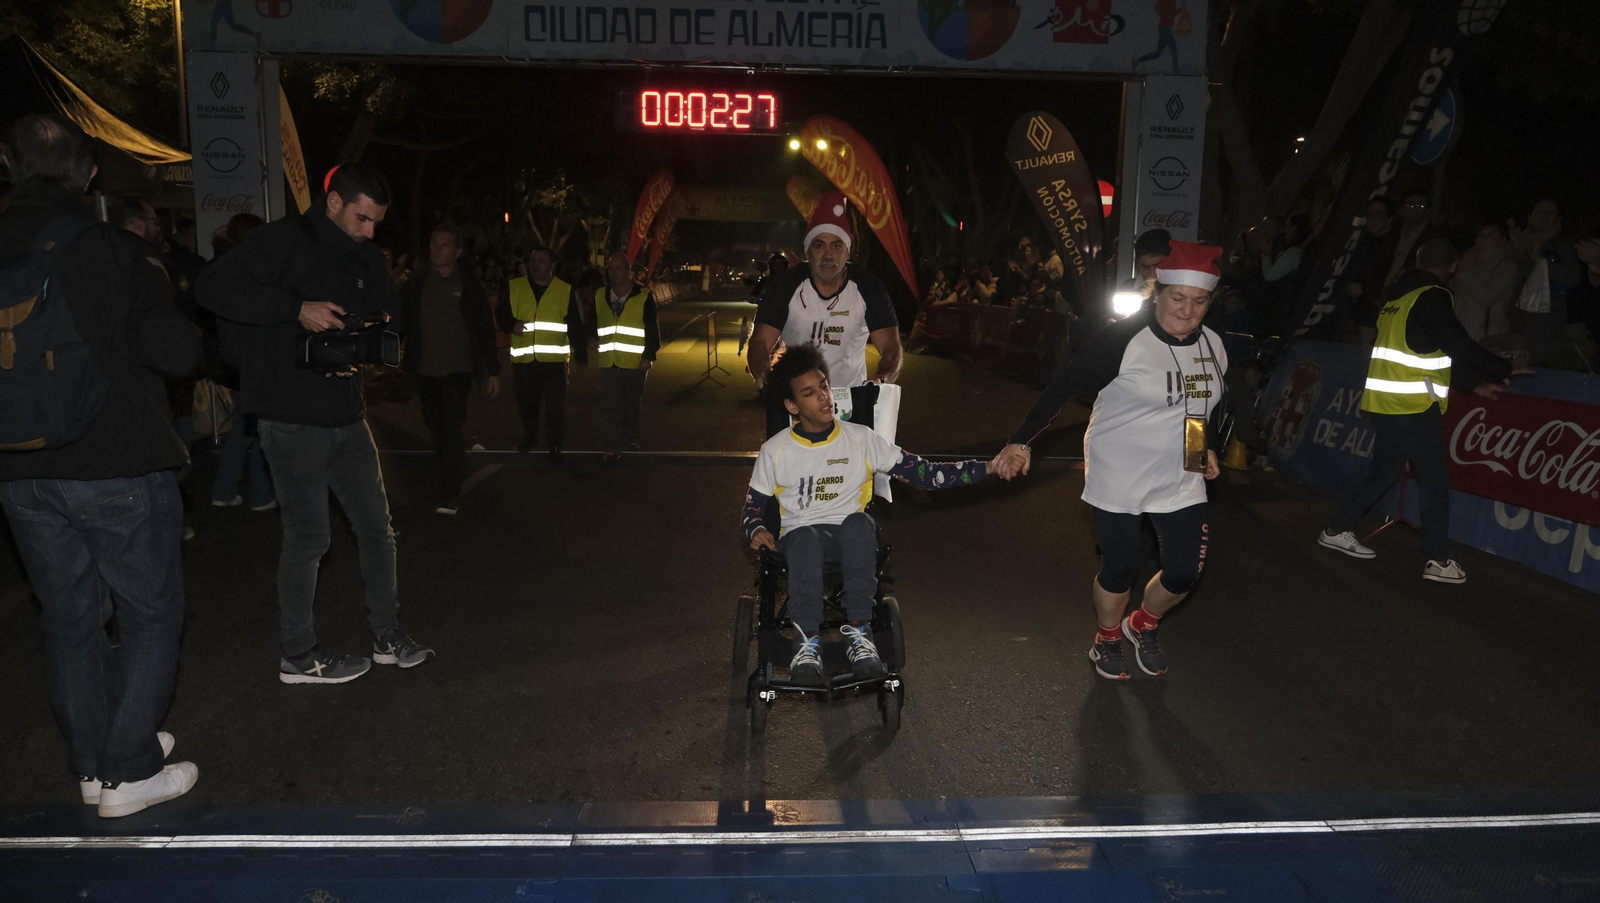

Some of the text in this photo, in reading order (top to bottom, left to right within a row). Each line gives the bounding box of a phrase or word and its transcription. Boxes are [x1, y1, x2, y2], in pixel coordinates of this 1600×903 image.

[319, 0, 357, 10] CIUDAD
[524, 5, 888, 49] CIUDAD DE ALMERÍA
[197, 105, 246, 114] RENAULT
[1150, 125, 1196, 134] RENAULT
[201, 151, 246, 159] NISSAN
[1185, 373, 1213, 382] CARROS
[1186, 390, 1212, 399] FUEGO
[1313, 418, 1345, 449] DE
[816, 475, 844, 485] CARROS
[815, 485, 825, 493] DE
[815, 493, 839, 501] FUEGO
